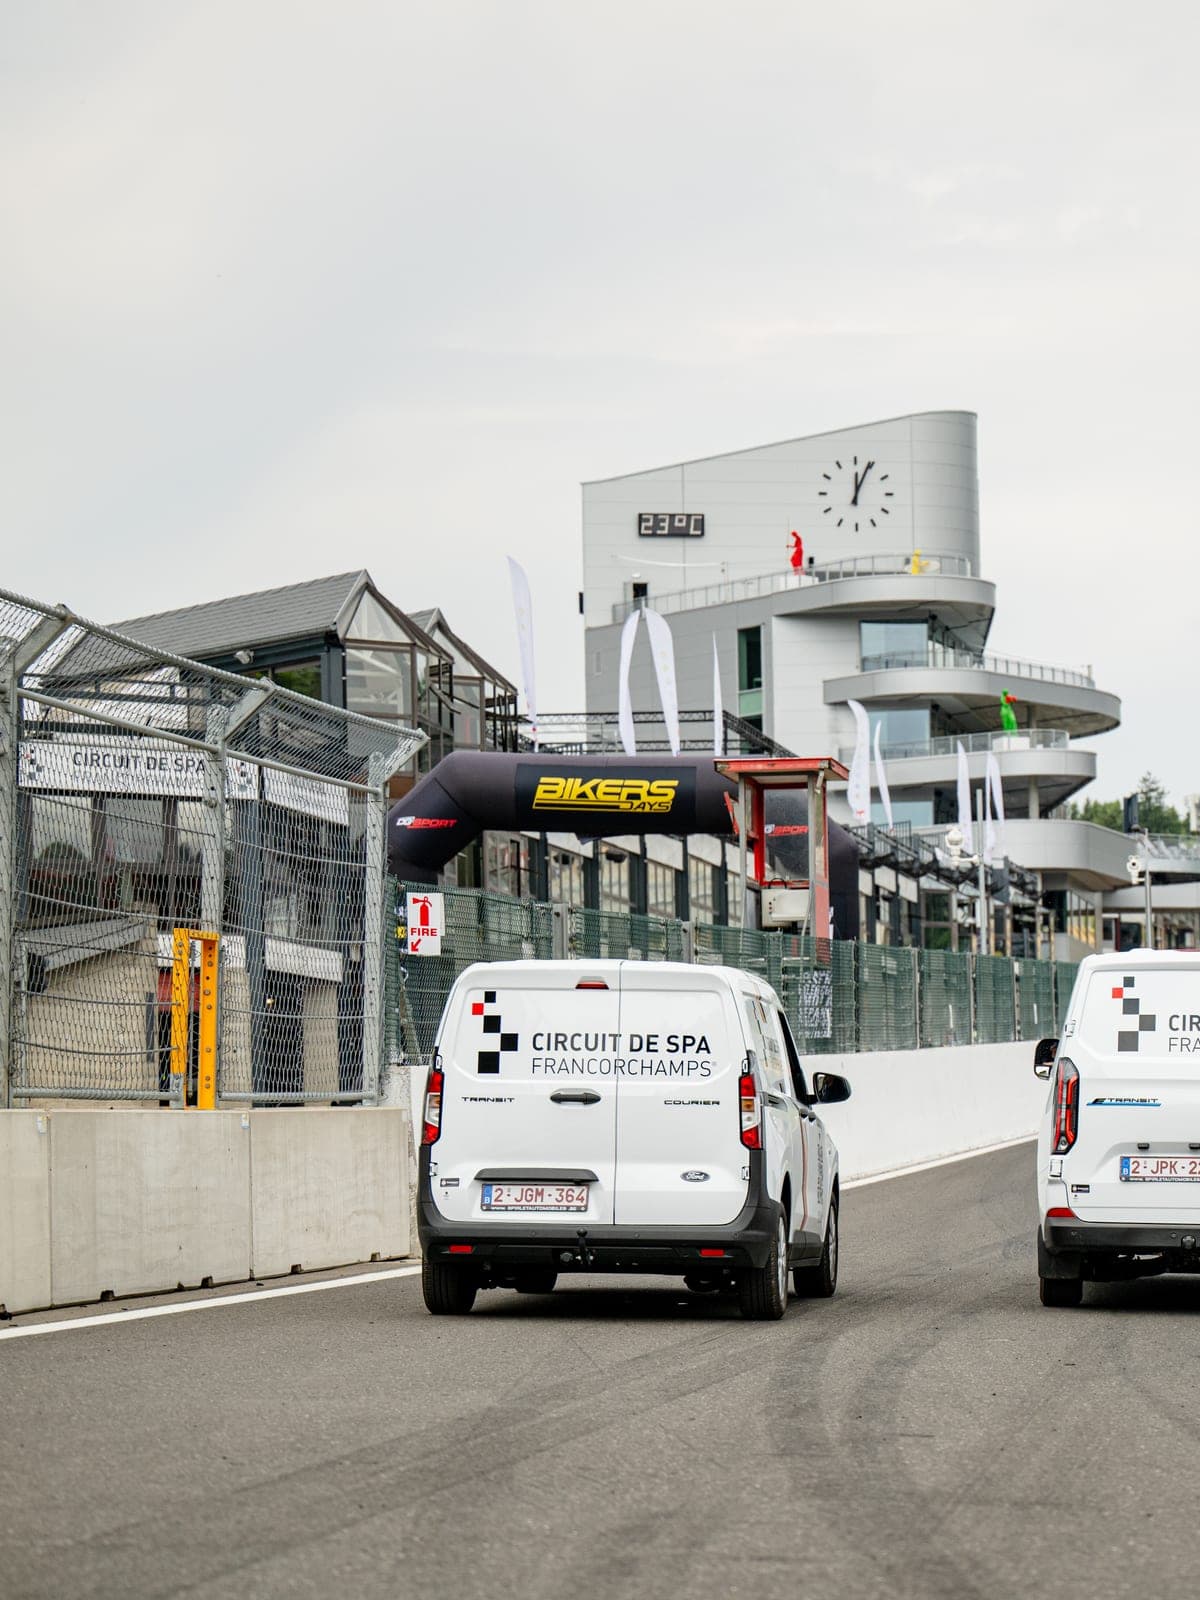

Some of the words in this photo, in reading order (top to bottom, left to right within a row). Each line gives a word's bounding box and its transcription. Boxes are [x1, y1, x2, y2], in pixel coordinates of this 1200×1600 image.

[73, 752, 140, 769] CIRCUIT
[146, 756, 168, 771] DE
[174, 758, 205, 773] SPA
[534, 777, 679, 801] BIKERS
[618, 800, 673, 812] DAYS
[410, 927, 438, 937] FIRE
[532, 1032, 622, 1051] CIRCUIT
[629, 1034, 659, 1052] DE
[666, 1035, 711, 1054] SPA
[532, 1058, 712, 1077] FRANCORCHAMPS
